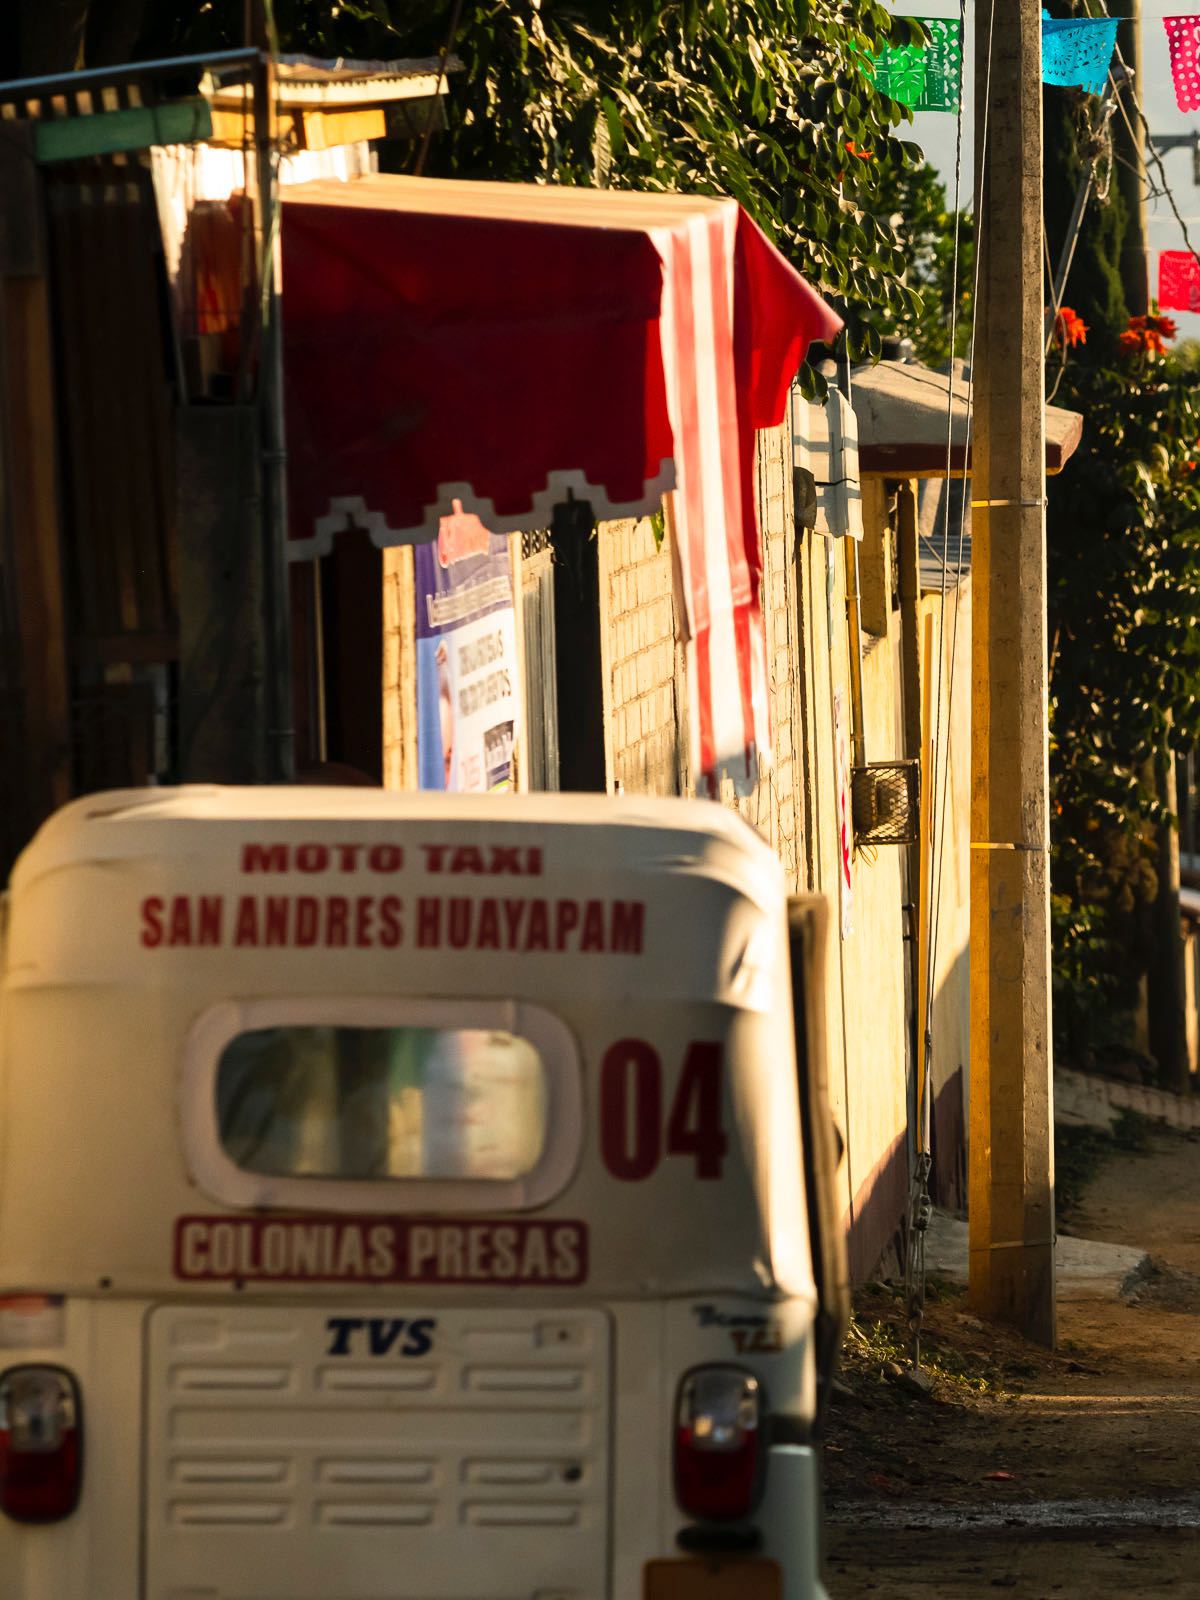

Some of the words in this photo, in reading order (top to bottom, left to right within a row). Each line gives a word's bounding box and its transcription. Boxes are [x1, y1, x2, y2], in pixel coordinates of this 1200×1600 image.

[241, 841, 404, 875] MOTO
[420, 843, 543, 877] TAXI
[141, 894, 223, 949] SAN
[234, 894, 403, 949] ANDRES
[416, 896, 646, 957] HUAYAPAM
[600, 1037, 730, 1182] 04
[181, 1222, 396, 1277] COLONIAS
[407, 1225, 579, 1278] PRESAS
[327, 1317, 437, 1358] TVS
